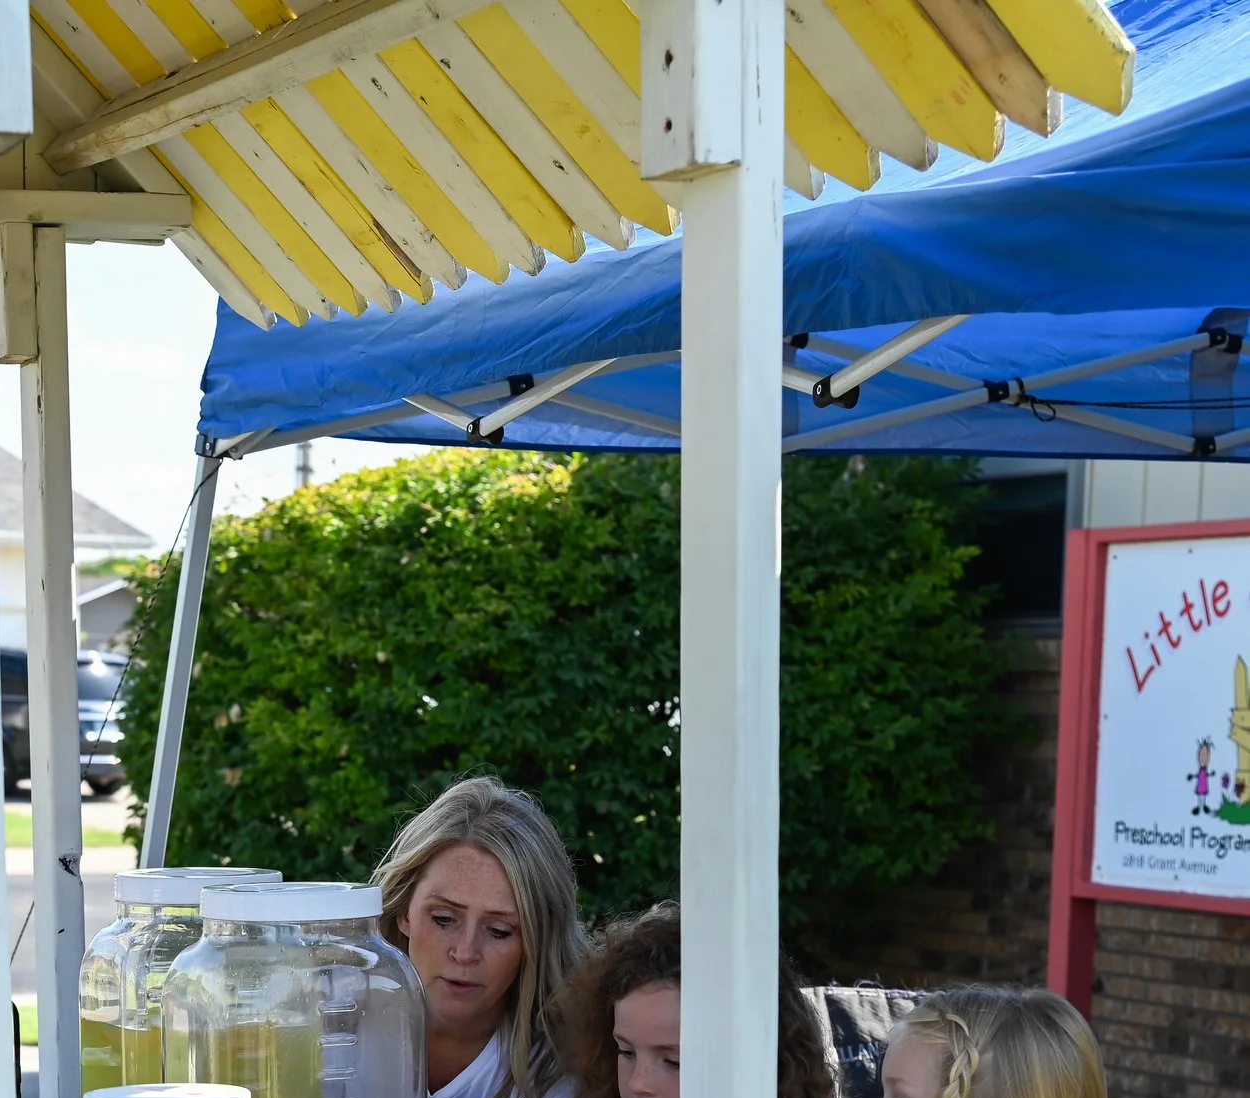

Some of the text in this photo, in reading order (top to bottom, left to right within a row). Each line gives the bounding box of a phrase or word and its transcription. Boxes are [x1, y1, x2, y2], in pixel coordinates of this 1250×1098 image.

[1126, 578, 1232, 693] Little
[1114, 820, 1185, 848] Preschool
[1148, 855, 1176, 871] Grant
[1179, 859, 1218, 875] Avenue
